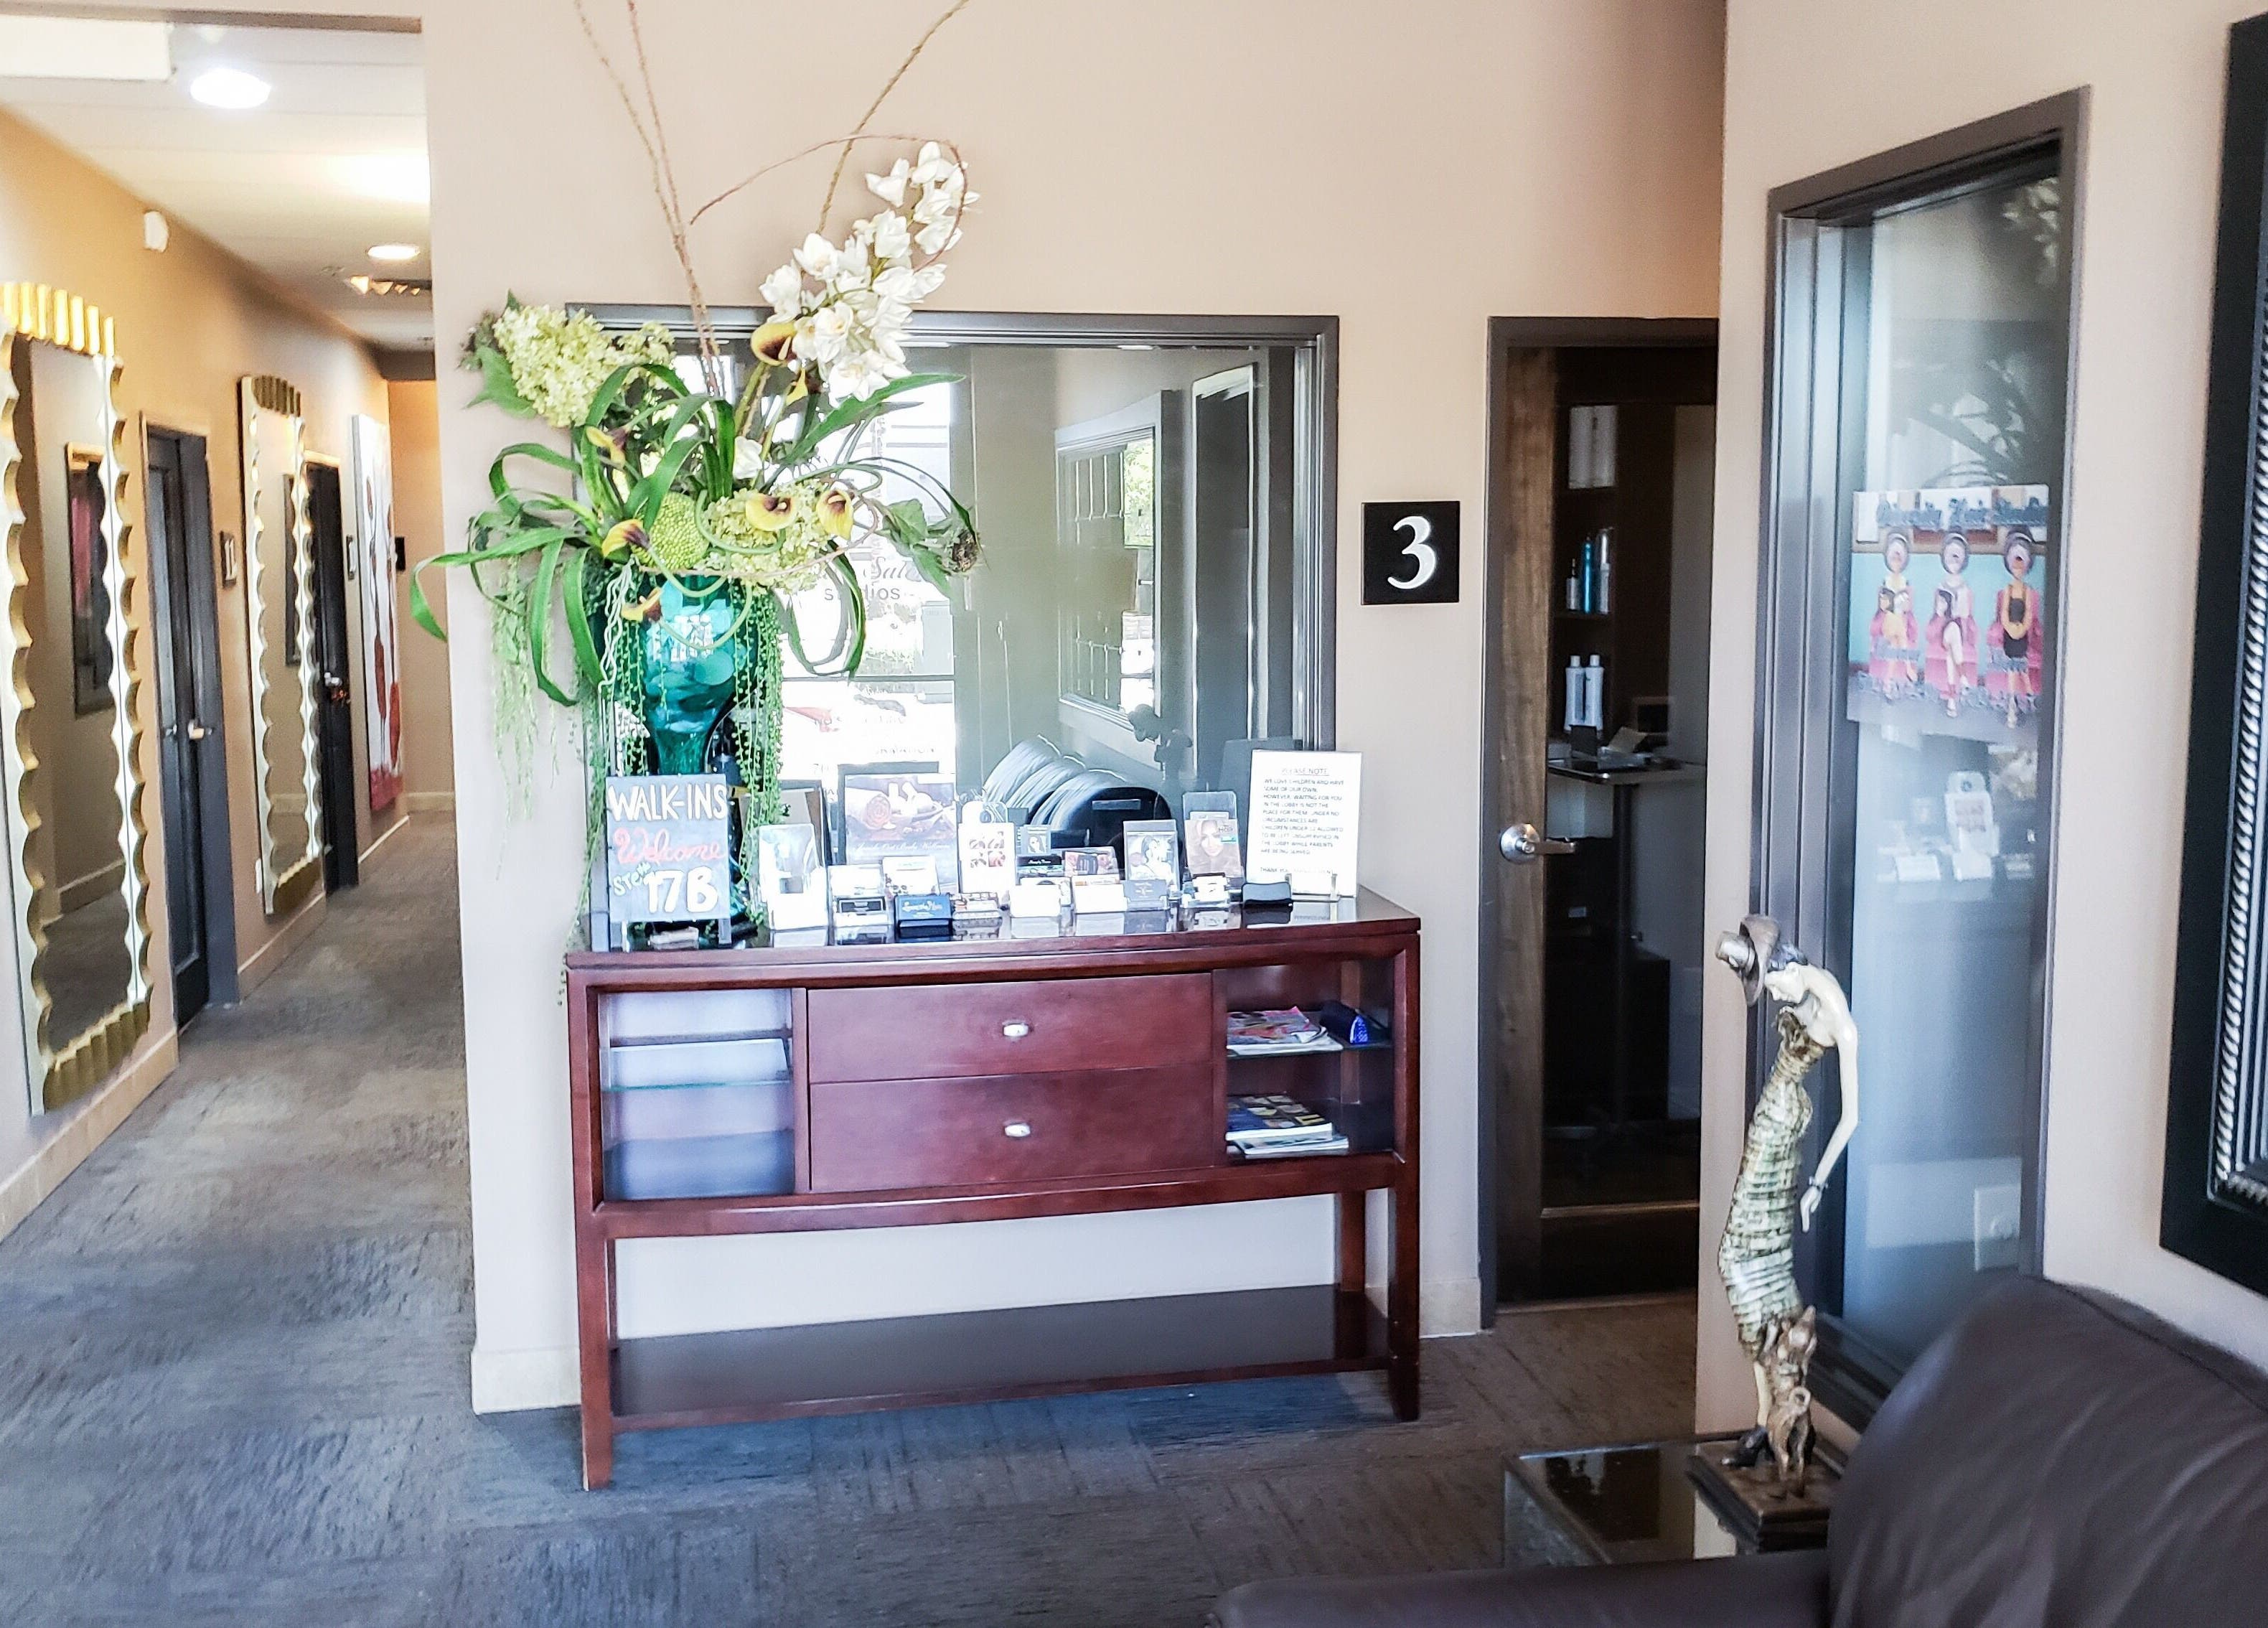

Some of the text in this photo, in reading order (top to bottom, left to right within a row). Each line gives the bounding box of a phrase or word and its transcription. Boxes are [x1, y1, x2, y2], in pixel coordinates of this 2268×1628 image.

[1388, 516, 1436, 589] 3
[608, 783, 728, 821] WALK-INS
[614, 827, 725, 866] Welcome
